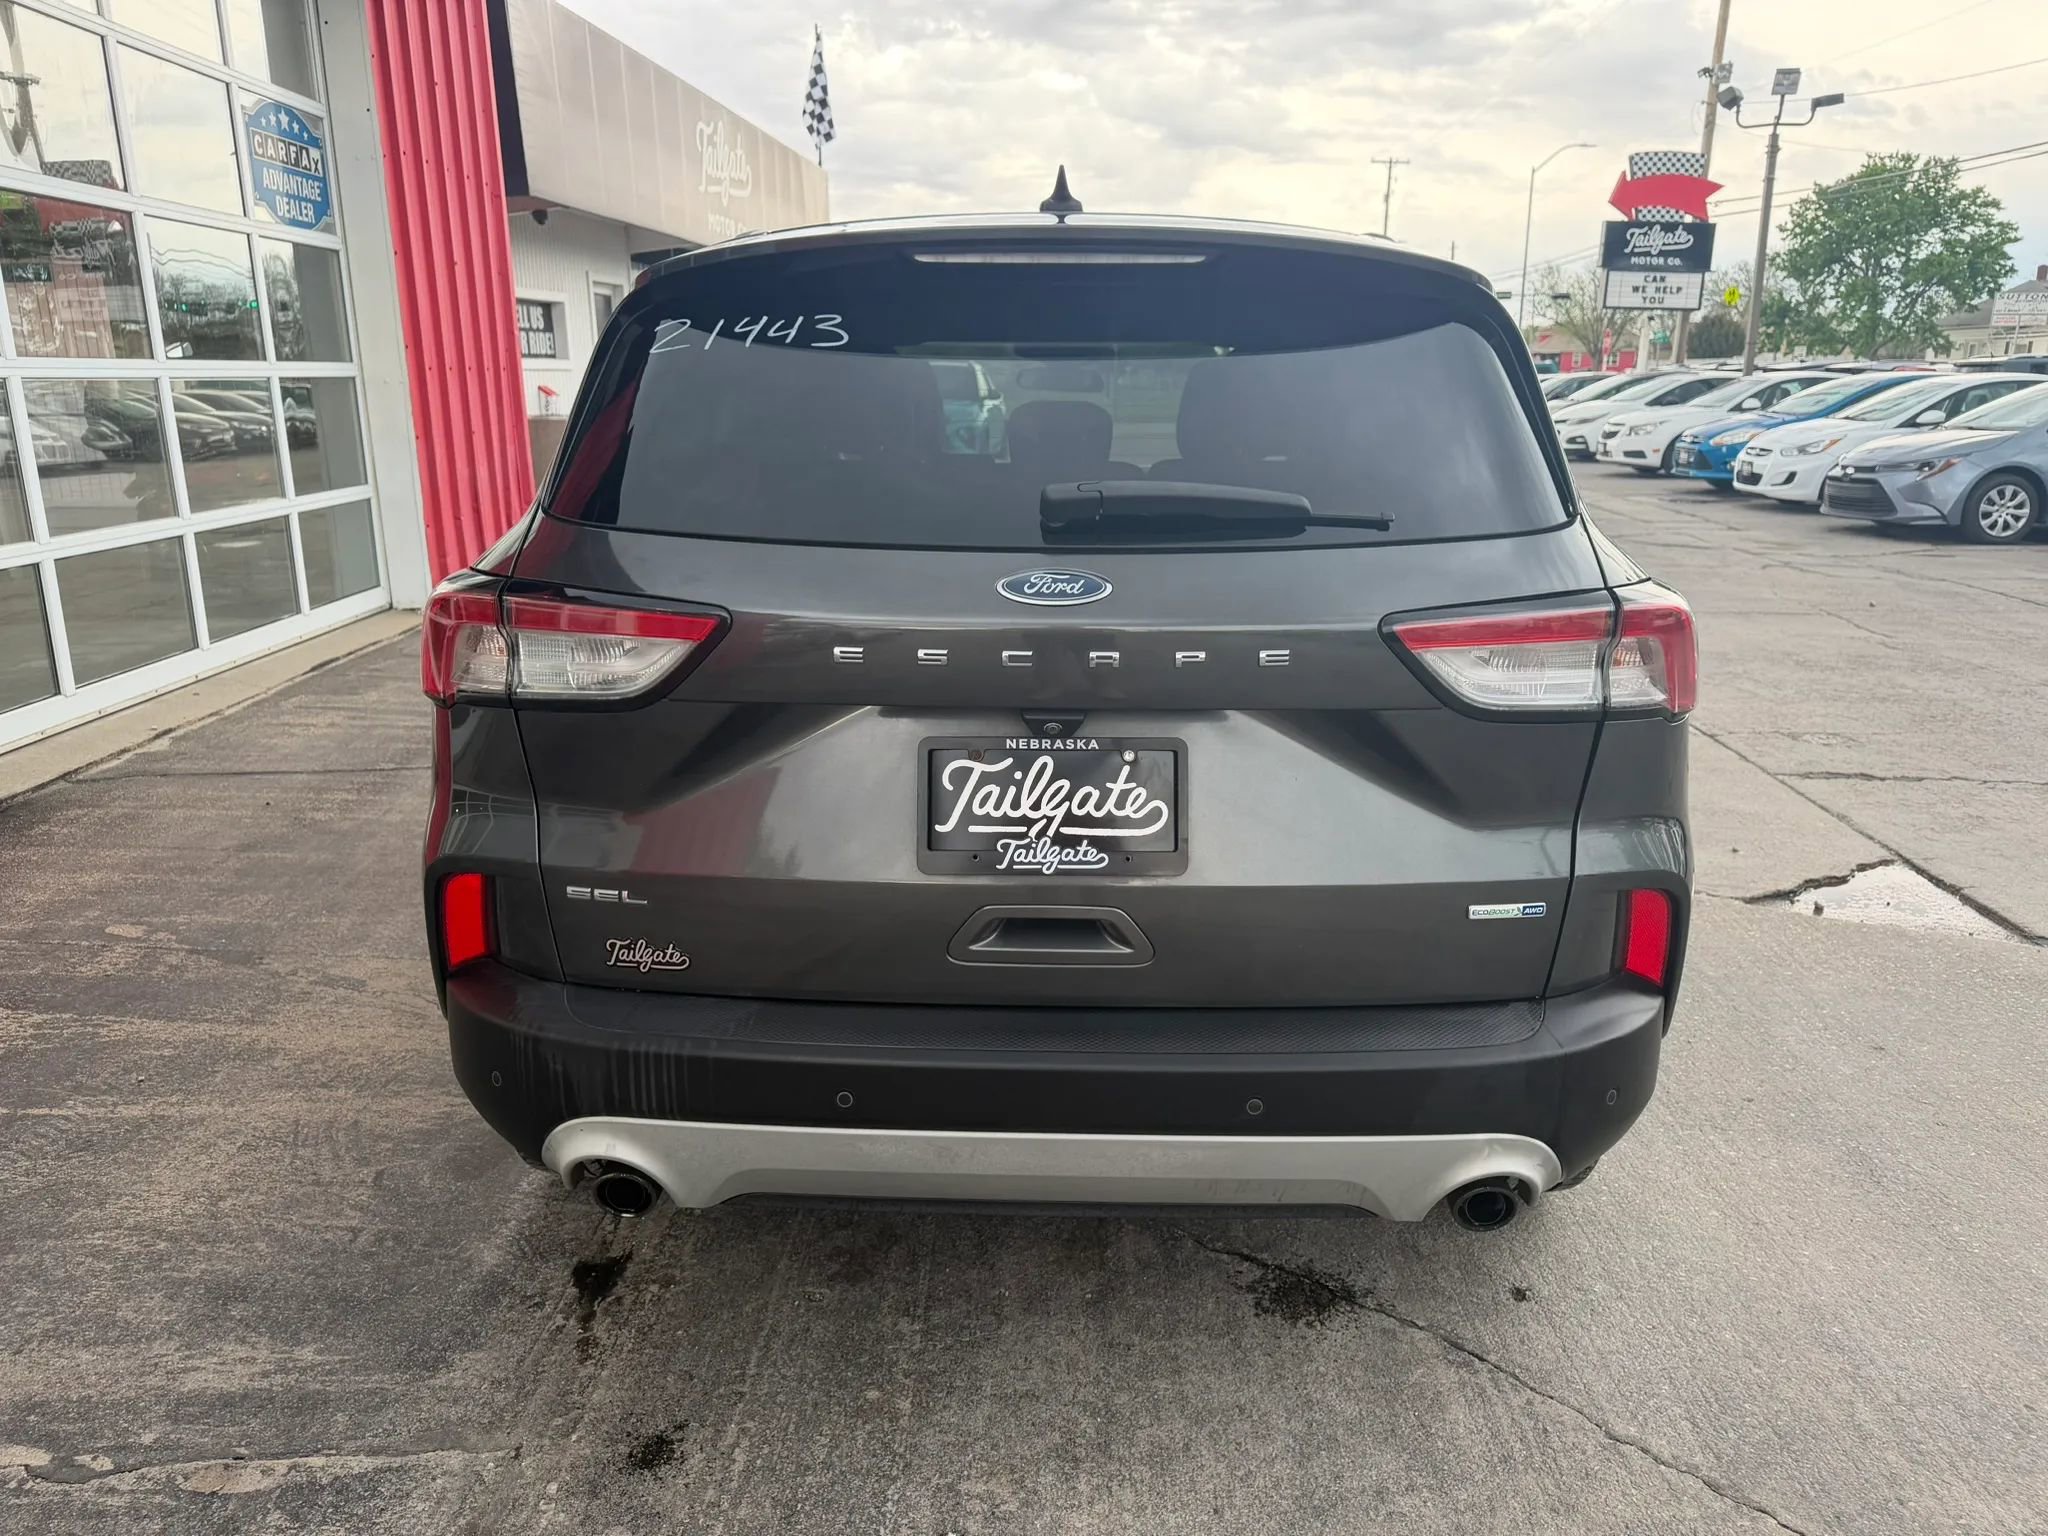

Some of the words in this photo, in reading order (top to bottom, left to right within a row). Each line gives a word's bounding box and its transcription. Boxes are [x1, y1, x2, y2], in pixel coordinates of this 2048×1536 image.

[253, 134, 321, 175] CARFAX
[696, 121, 753, 207] Tailgate
[263, 167, 322, 201] ADVANTAGE
[275, 195, 315, 224] DEALER
[1624, 224, 1694, 255] Tailgate
[1630, 256, 1664, 266] MOTOR
[1632, 285, 1647, 294] WE
[1655, 286, 1682, 295] HELP
[1644, 275, 1666, 283] CAN
[1642, 296, 1664, 304] YOU
[529, 305, 545, 330] US
[528, 331, 555, 355] RIDE!
[650, 314, 849, 353] 21443
[1023, 573, 1085, 596] Ford
[832, 645, 1291, 668] ESCAPE
[1005, 738, 1100, 750] NEBRASKA
[934, 754, 1169, 842] Tailgate
[996, 837, 1109, 874] Tailgate
[566, 886, 648, 904] SEL
[1523, 906, 1543, 915] AWD
[606, 939, 690, 972] Tailgate
